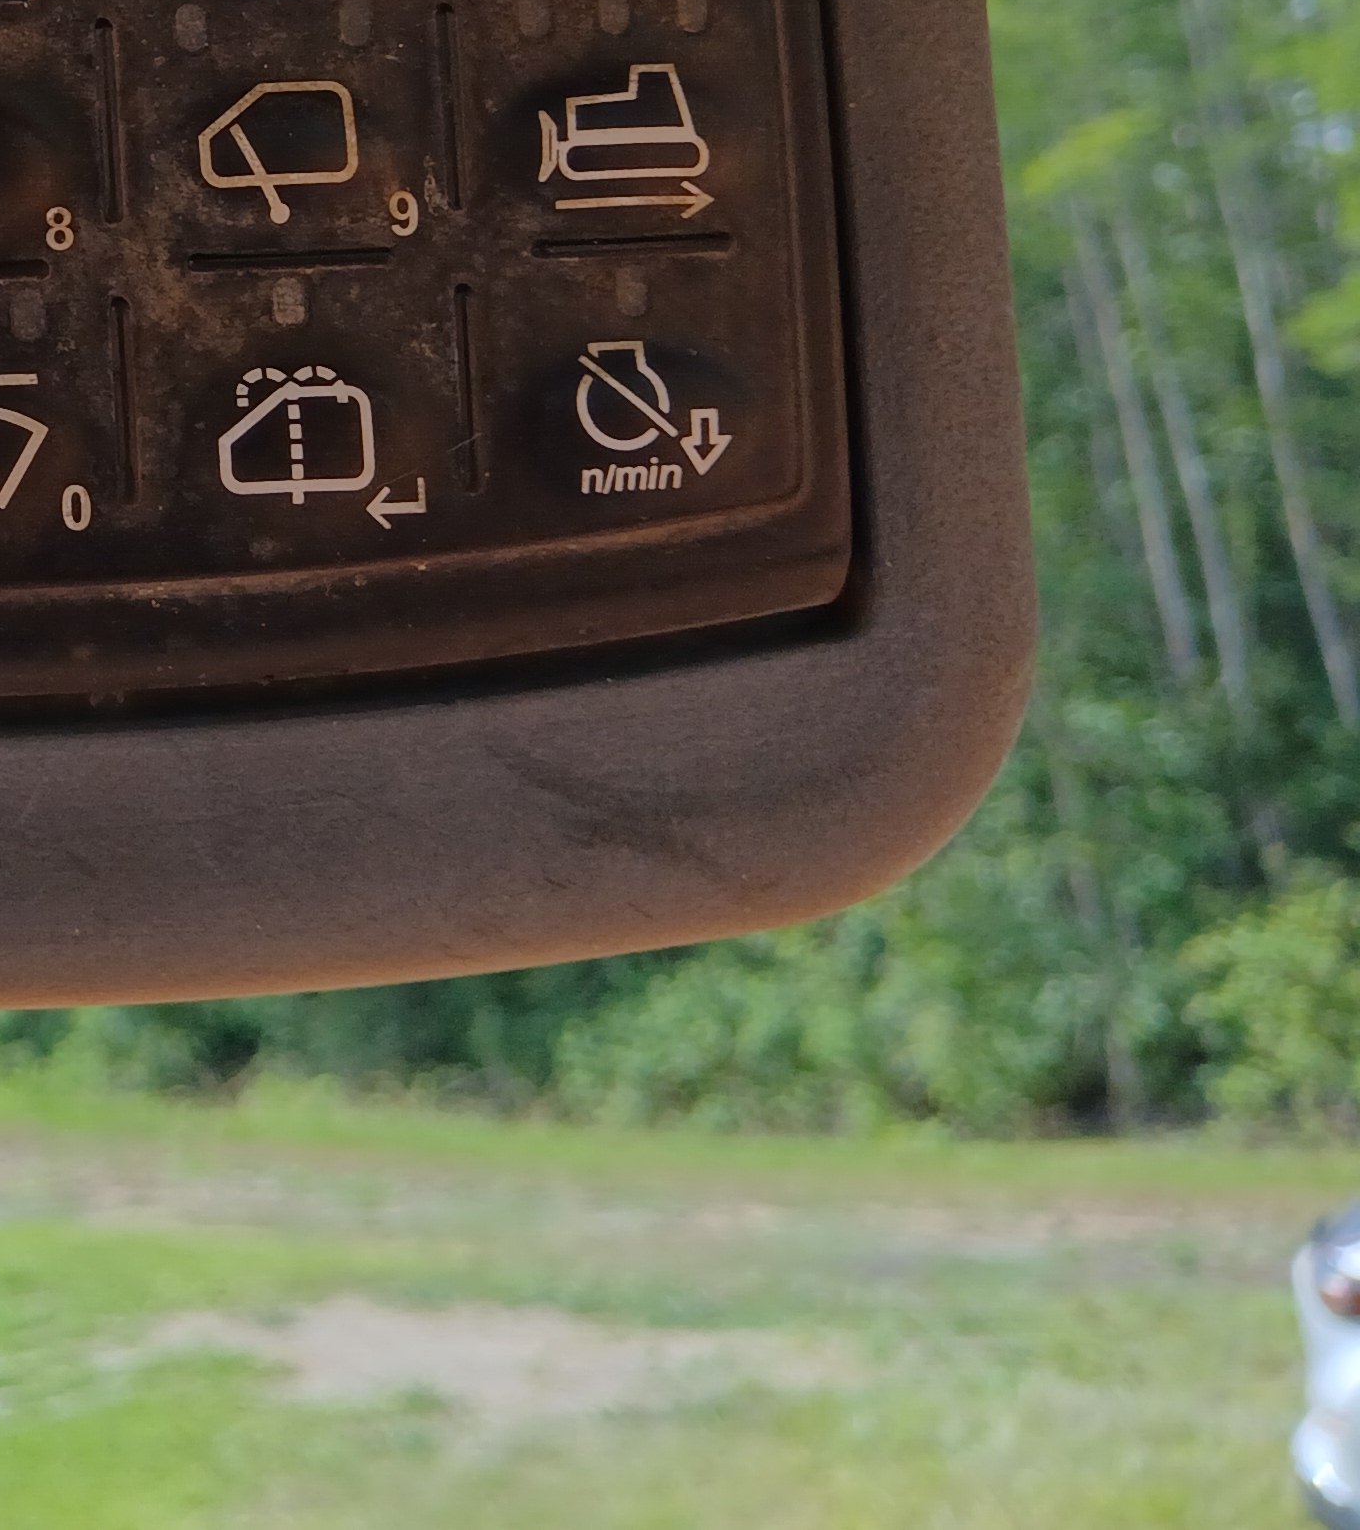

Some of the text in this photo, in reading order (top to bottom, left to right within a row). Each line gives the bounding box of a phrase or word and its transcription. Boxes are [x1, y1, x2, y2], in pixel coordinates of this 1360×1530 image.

[45, 206, 75, 251] 8
[388, 191, 419, 237] 9
[581, 458, 682, 497] n/min
[61, 485, 92, 531] 0
